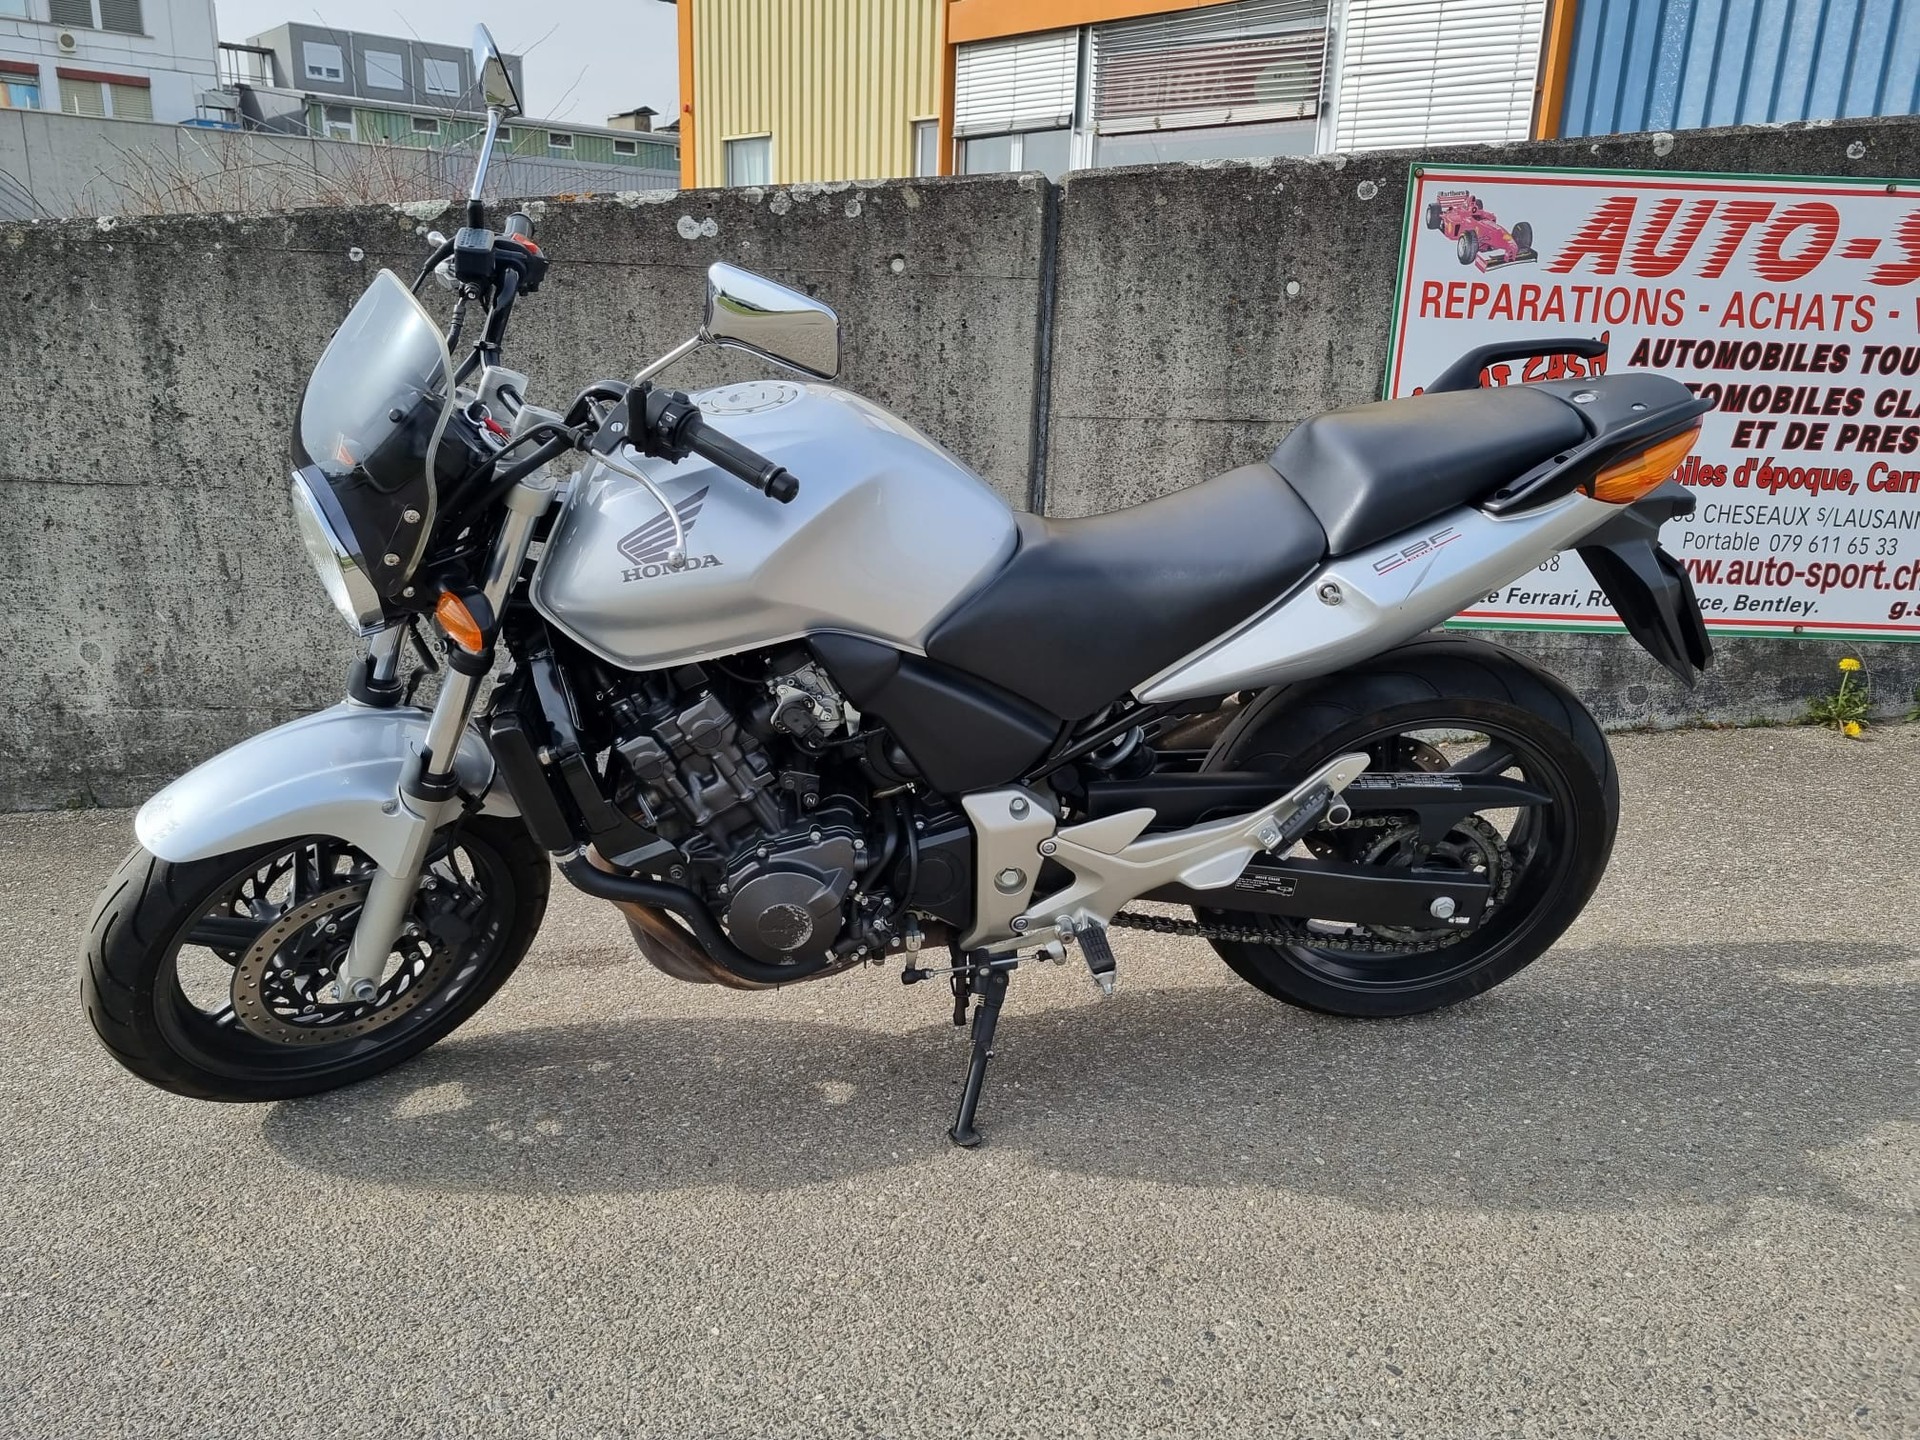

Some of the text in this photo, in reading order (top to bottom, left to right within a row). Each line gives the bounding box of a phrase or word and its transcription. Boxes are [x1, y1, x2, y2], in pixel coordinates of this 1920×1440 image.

[1419, 281, 1685, 327] REPARATIONS
[1719, 291, 1876, 333] ACHATS
[1628, 338, 1850, 374] AUTOMOBILES
[1731, 420, 1777, 449] ET
[1782, 422, 1830, 451] DE
[1733, 457, 1859, 497] d'époque,
[1703, 503, 1811, 526] CHESEAUX
[1372, 527, 1453, 572] CBF
[1683, 531, 1898, 556] Portable 079 611 65 33
[620, 554, 723, 582] HONDA
[1506, 587, 1581, 608] Ferrari,
[1733, 594, 1818, 616] Bentley.
